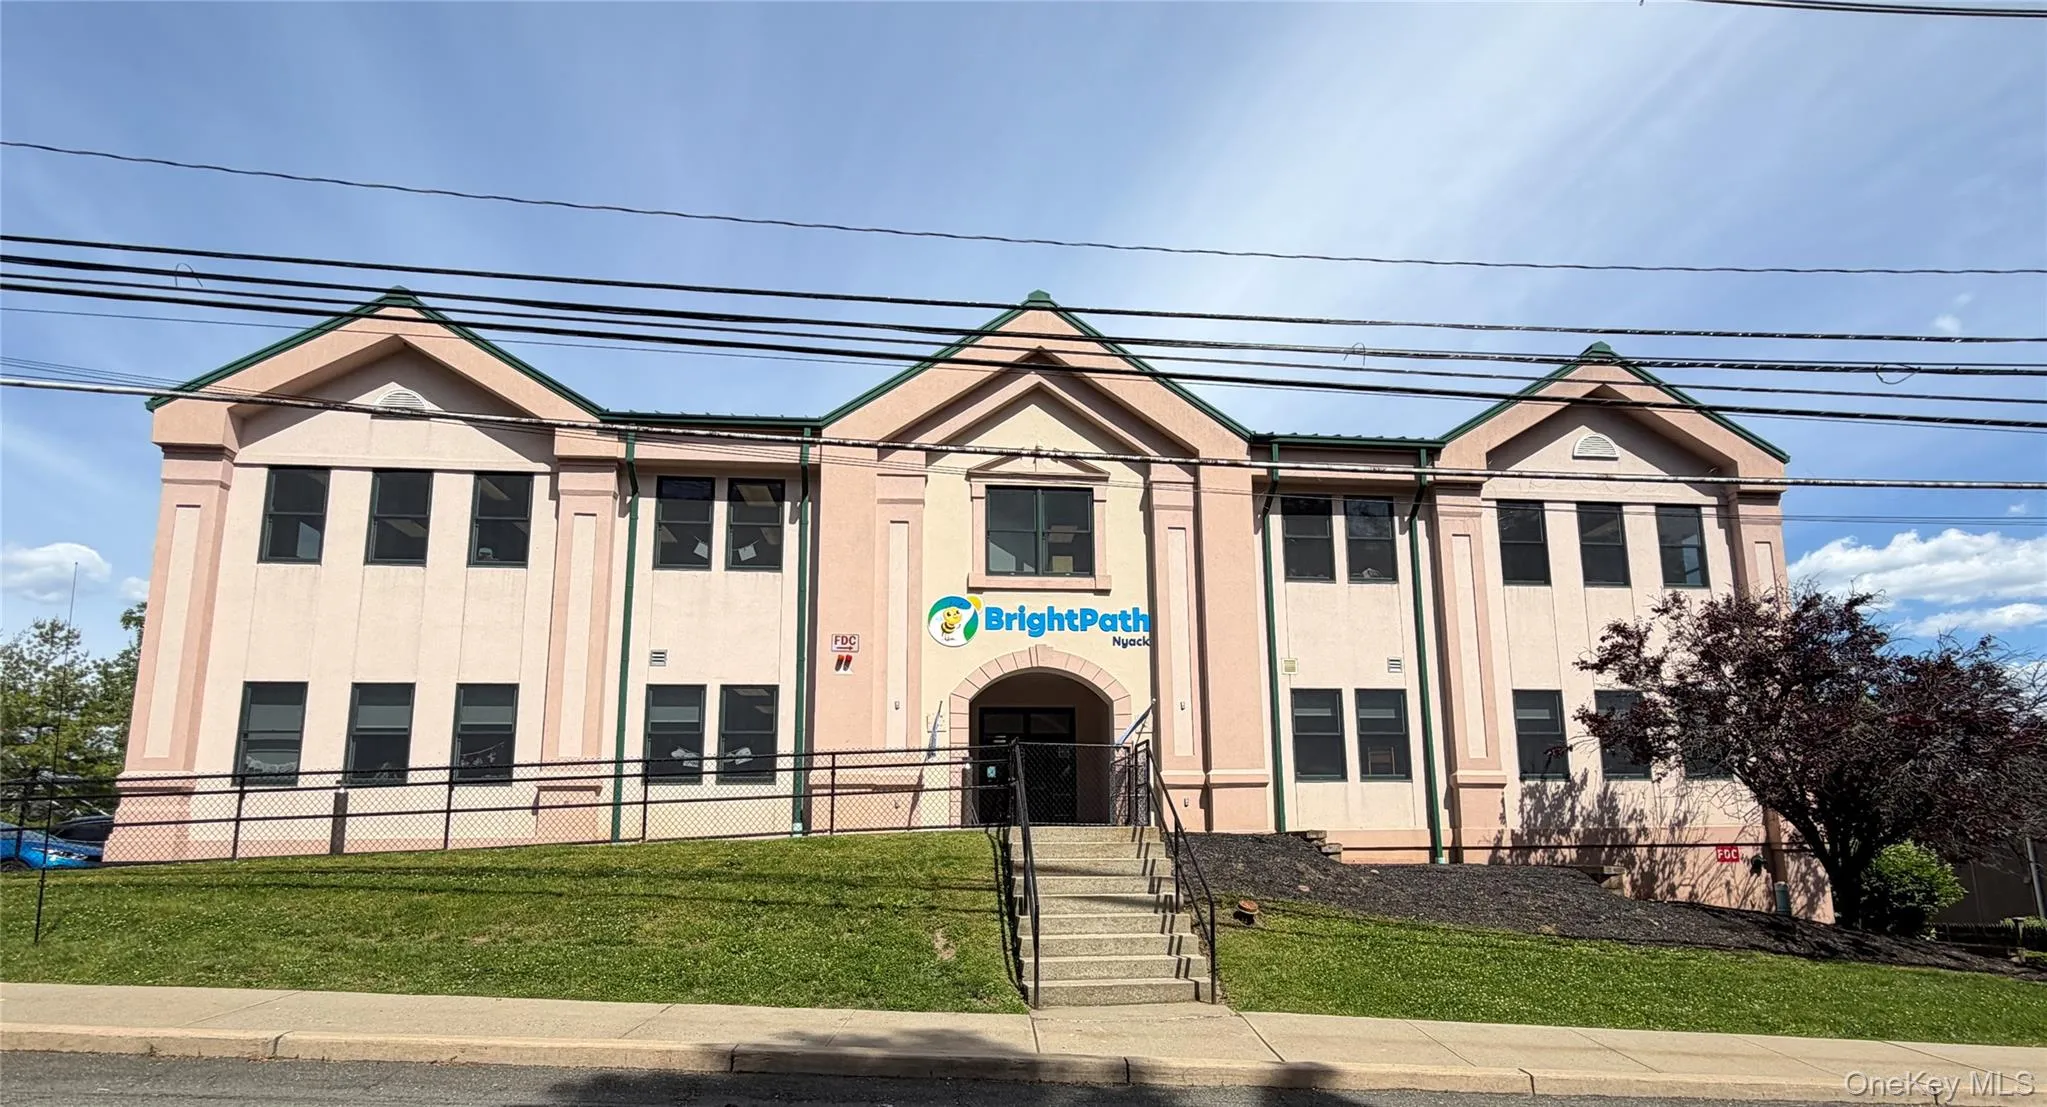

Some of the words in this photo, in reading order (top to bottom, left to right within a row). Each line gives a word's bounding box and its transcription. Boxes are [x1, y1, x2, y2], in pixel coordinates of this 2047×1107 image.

[985, 605, 1150, 638] BrightPath
[834, 635, 856, 646] FDC
[1112, 635, 1151, 649] Nyack
[1717, 849, 1738, 860] FDC
